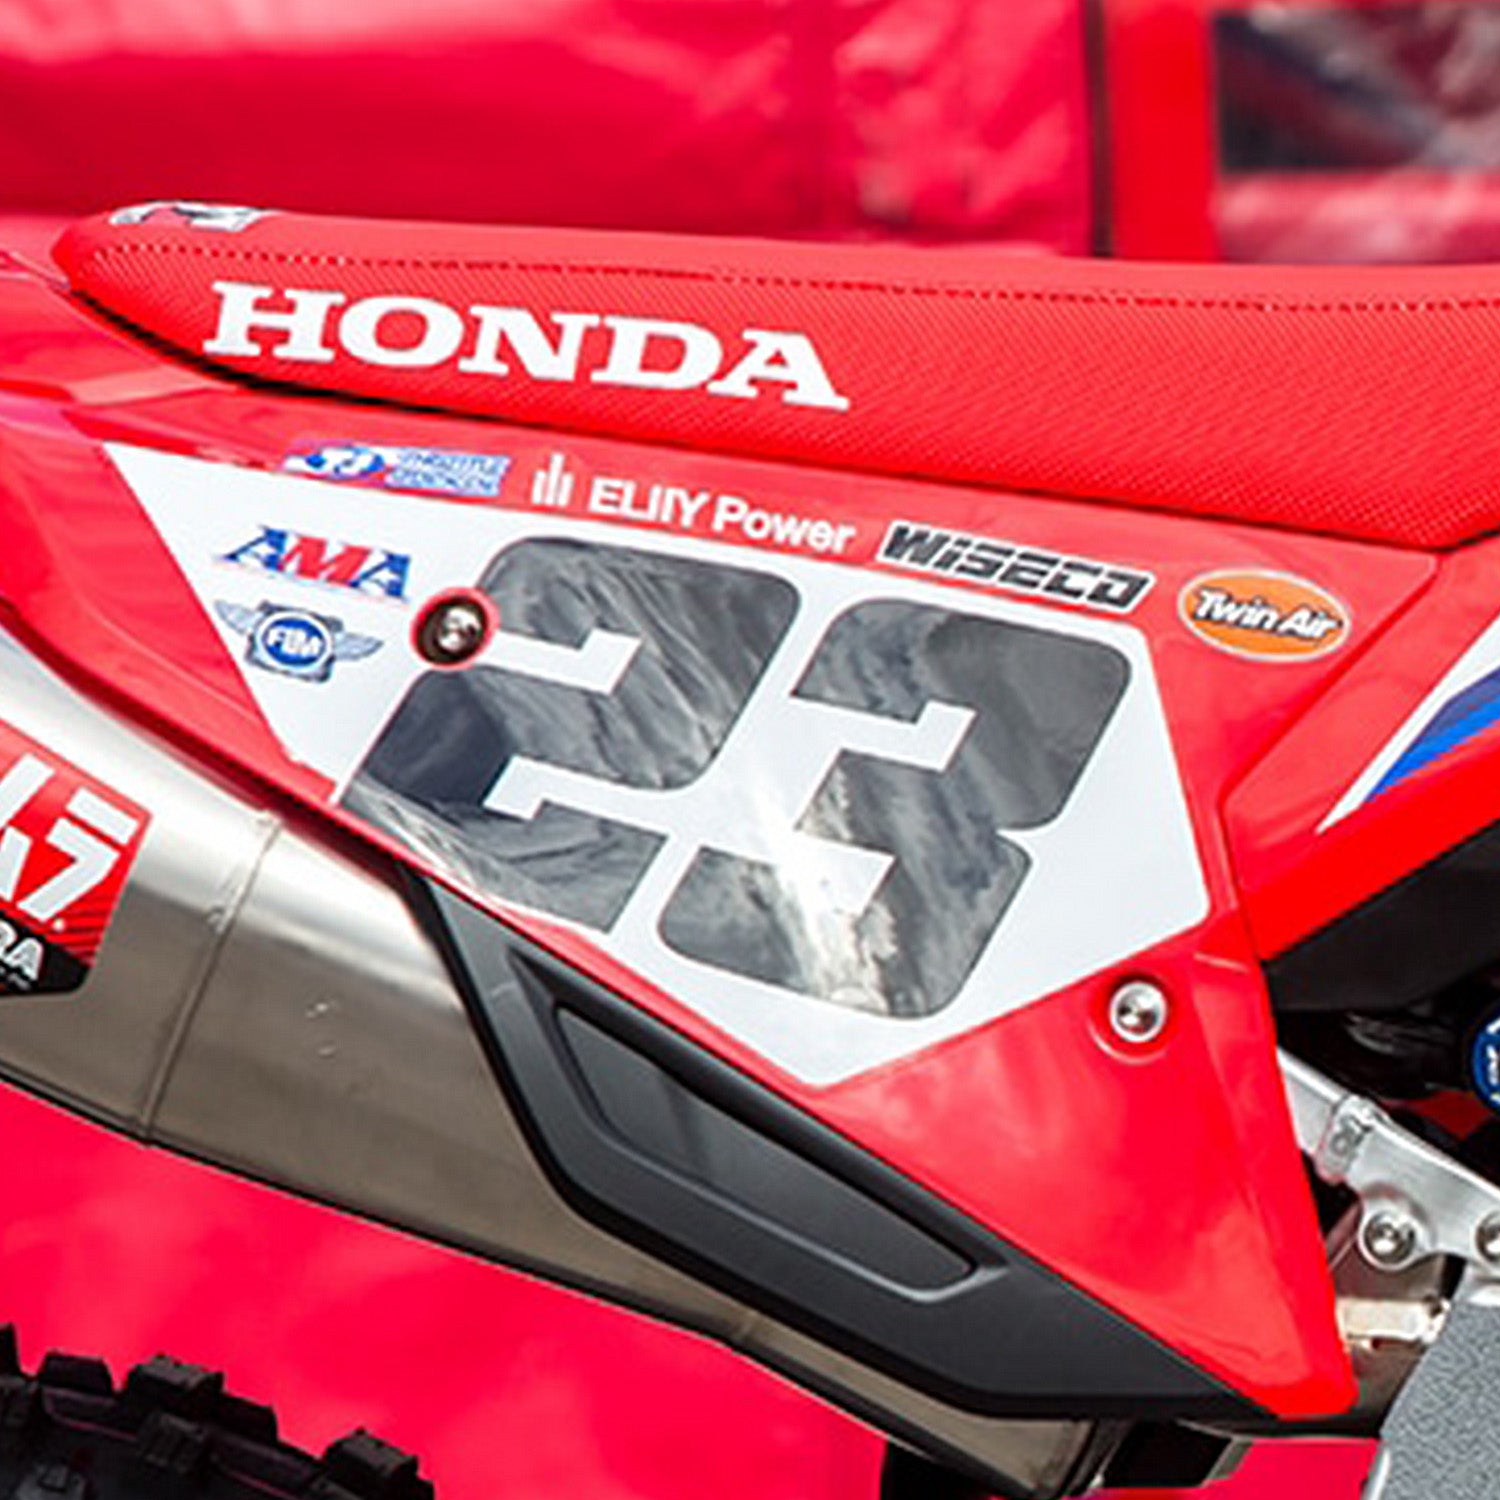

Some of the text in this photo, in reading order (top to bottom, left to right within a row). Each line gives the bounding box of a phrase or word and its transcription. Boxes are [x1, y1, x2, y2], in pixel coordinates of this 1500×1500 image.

[203, 281, 850, 411] HONDA
[222, 524, 412, 602] AMA
[712, 496, 856, 554] Power
[1196, 588, 1342, 643] Twin Air
[338, 536, 1132, 1019] 23
